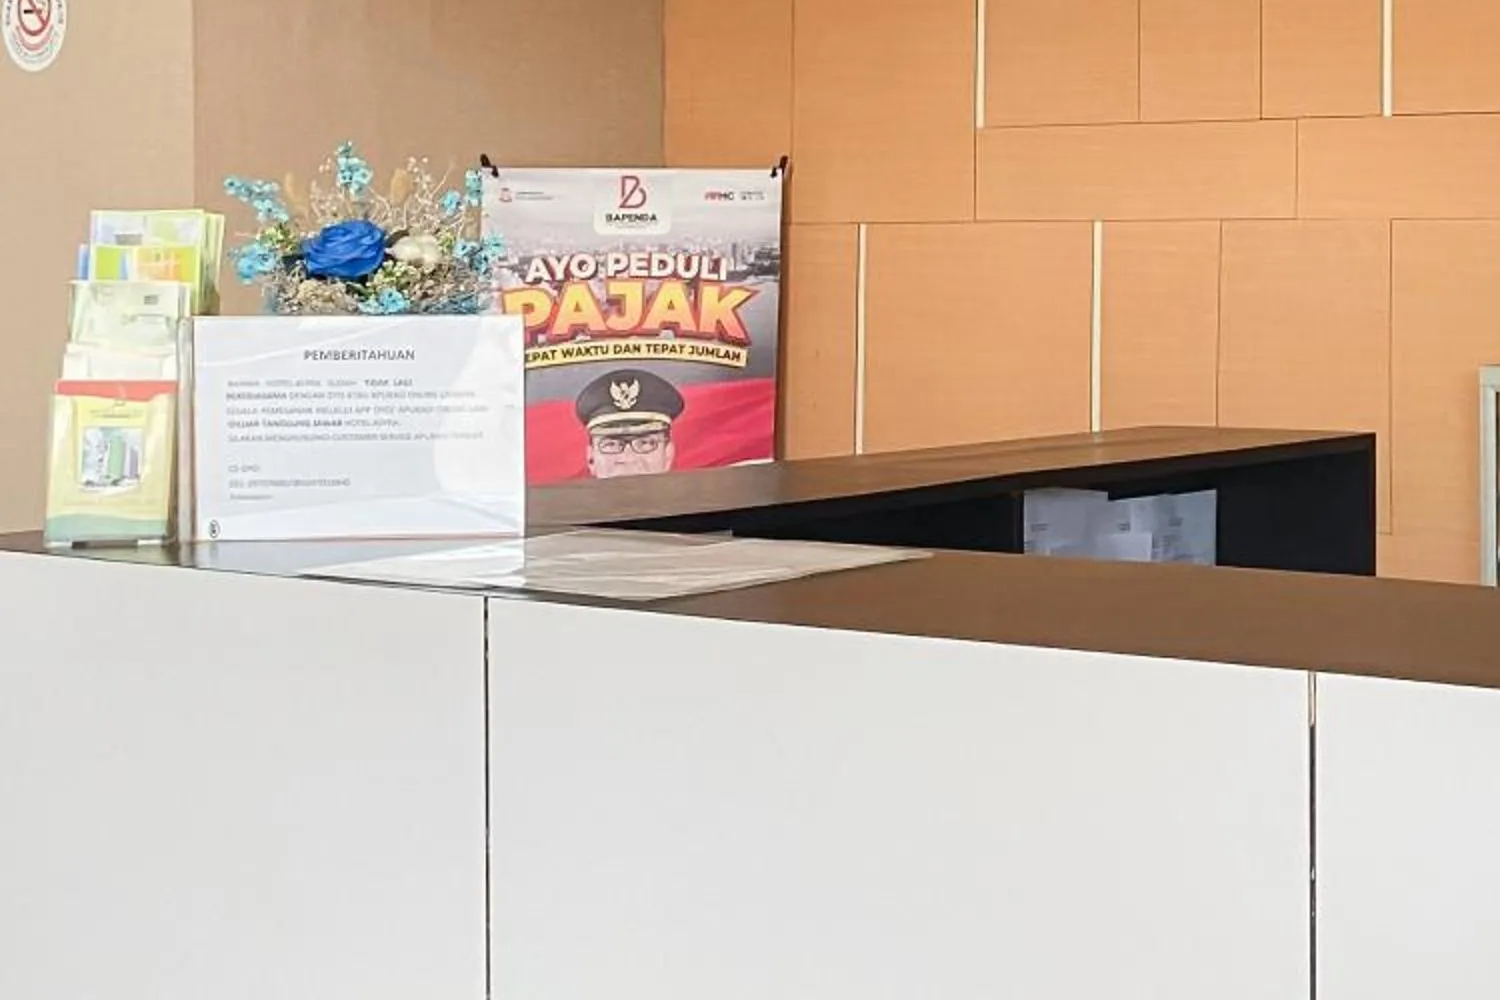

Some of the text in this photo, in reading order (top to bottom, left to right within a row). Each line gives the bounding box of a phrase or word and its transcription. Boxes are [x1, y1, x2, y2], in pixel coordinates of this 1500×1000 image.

[605, 213, 657, 223] BAPENDA
[525, 253, 728, 283] AYO PEDULI
[502, 280, 757, 343] PAJAK
[303, 349, 416, 361] PEMBERITAHUAN
[526, 349, 557, 363] EPAT
[561, 345, 609, 359] WAKTU
[613, 343, 641, 355] DAN
[645, 343, 686, 354] TEPAT
